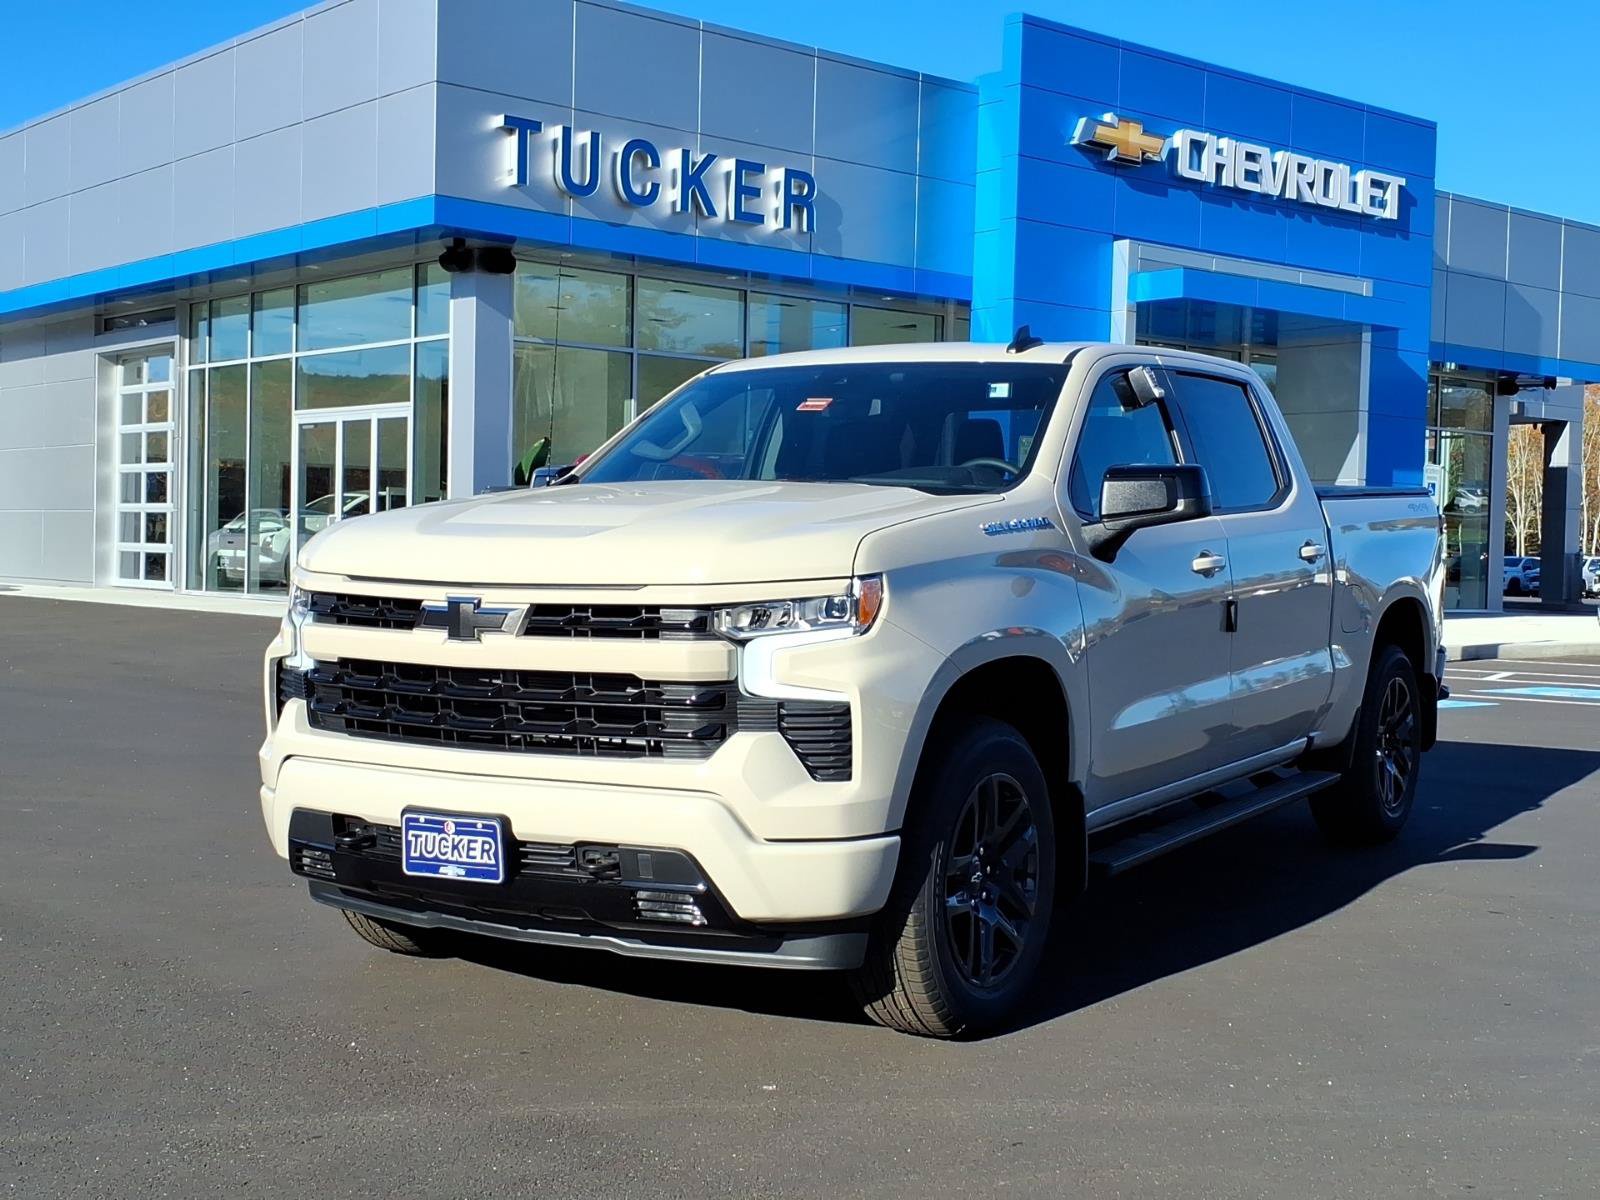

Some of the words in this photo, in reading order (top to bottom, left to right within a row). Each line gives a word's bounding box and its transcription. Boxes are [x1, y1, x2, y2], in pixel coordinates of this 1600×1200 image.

[500, 114, 817, 233] TUCKER
[1173, 128, 1406, 219] CHEVROLET
[407, 829, 496, 865] TUCKER
